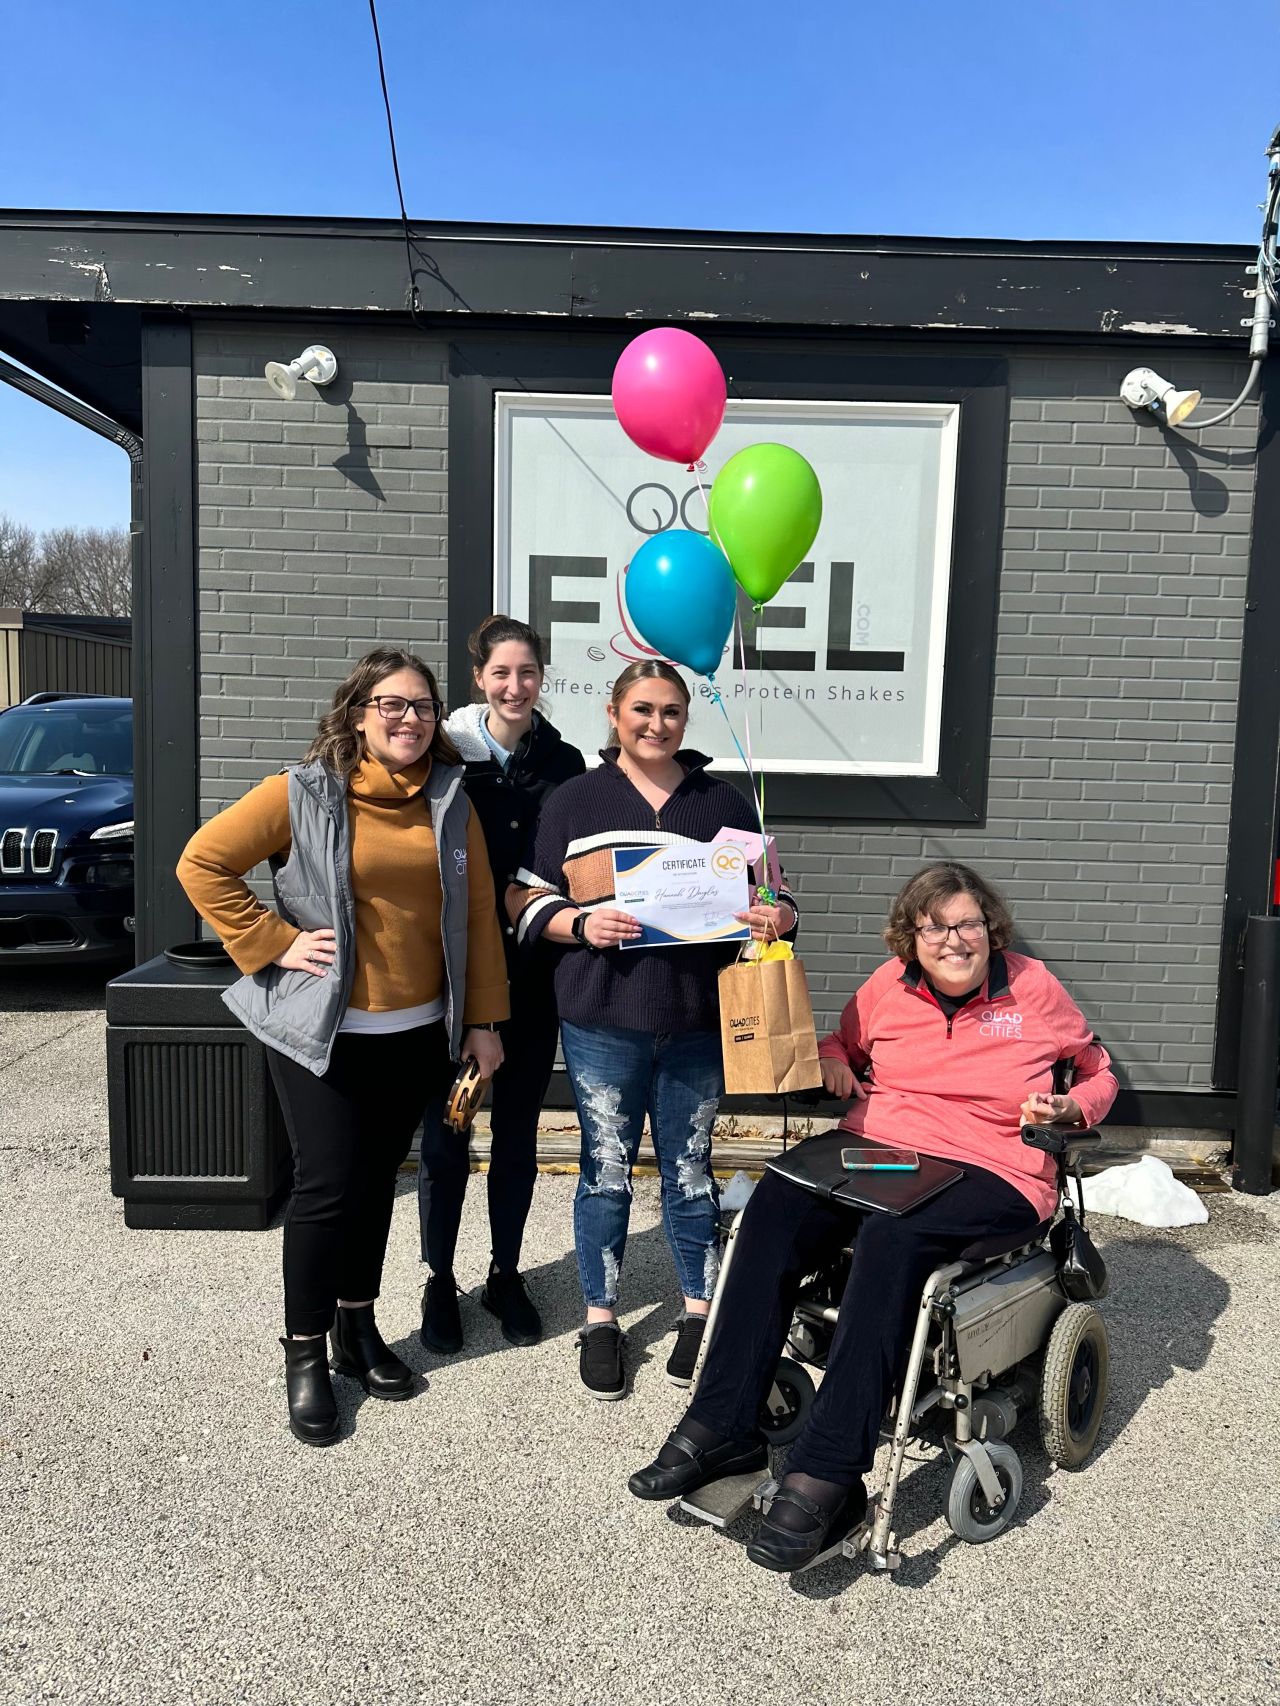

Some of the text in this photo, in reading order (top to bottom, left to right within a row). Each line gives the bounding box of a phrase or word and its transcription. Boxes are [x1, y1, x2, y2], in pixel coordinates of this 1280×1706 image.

[828, 685, 905, 702] Shakes
[662, 858, 706, 870] CERTIFICATE
[717, 855, 741, 870] QC
[981, 1010, 1023, 1024] QUAD
[979, 1025, 1022, 1039] CITIES
